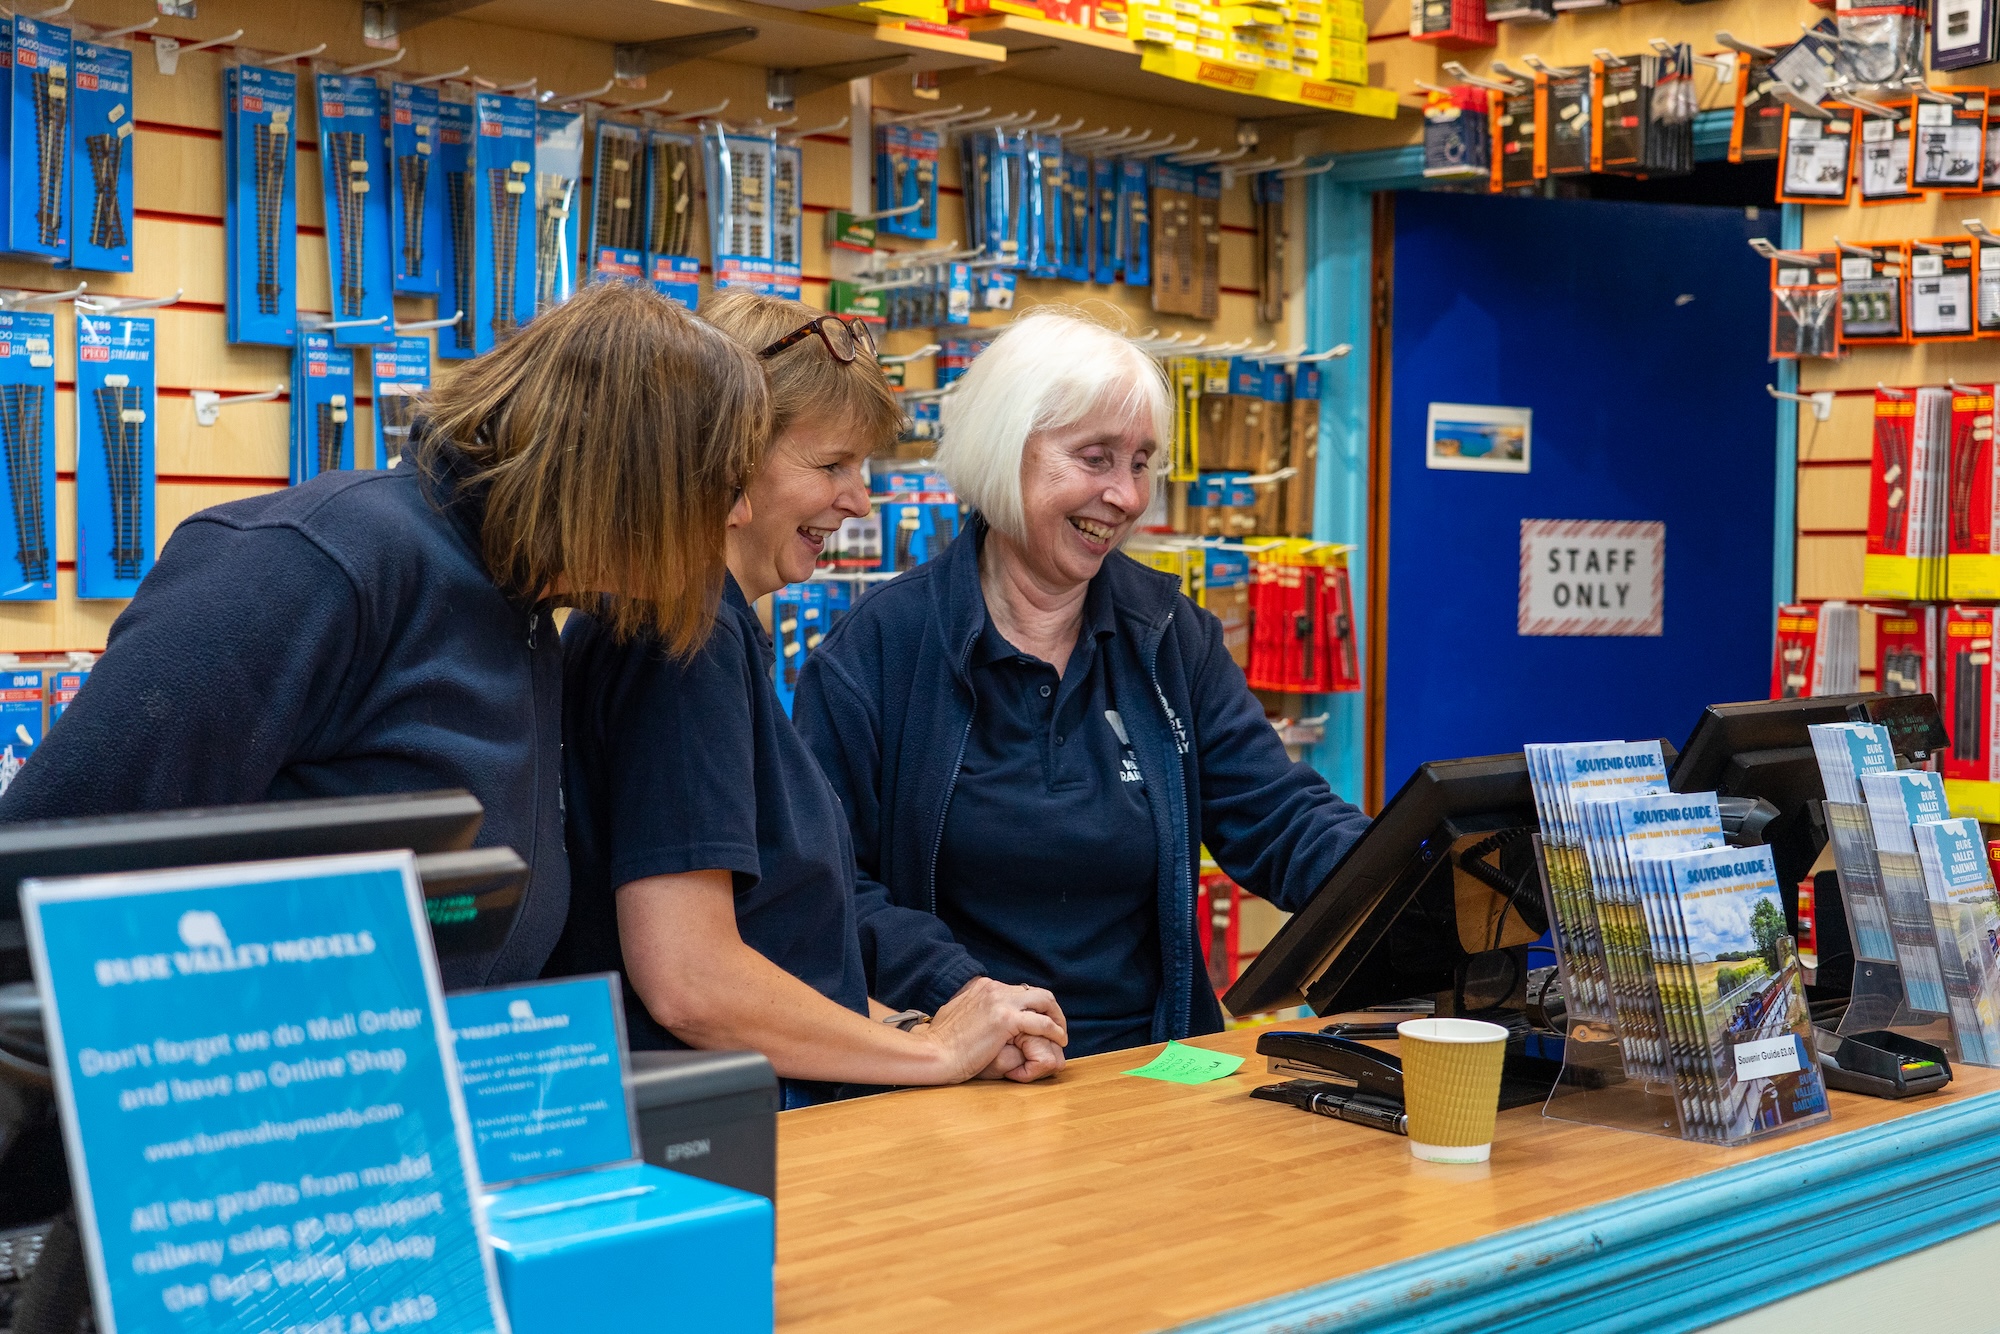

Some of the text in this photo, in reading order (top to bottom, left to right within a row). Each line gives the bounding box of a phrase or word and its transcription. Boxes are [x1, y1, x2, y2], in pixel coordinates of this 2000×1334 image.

[81, 320, 111, 331] SE96
[83, 347, 150, 362] PECO STREAMLINE
[1548, 547, 1637, 575] STAFF
[1553, 581, 1631, 610] ONLY
[1866, 743, 1884, 755] BURE
[1576, 754, 1656, 773] SOUVENIR GUIDE
[1863, 755, 1886, 767] VALLEY
[1861, 766, 1888, 776] RAILWAY
[1572, 781, 1589, 789] STEAM
[1590, 779, 1606, 788] TRAINS
[1623, 776, 1646, 785] NORFOLK
[1920, 790, 1938, 802] BURE
[1633, 805, 1712, 825] SOUVENIR GUIDE
[1917, 801, 1940, 813] VALLEY
[1916, 812, 1942, 824] RAILWAY
[1629, 832, 1646, 841] STEAM
[1647, 831, 1663, 839] TRAINS
[1670, 829, 1680, 837] THE
[1680, 827, 1701, 836] NORFOLK
[1955, 839, 1973, 851] BURE
[1952, 850, 1975, 863] VALLEY
[1687, 859, 1767, 884] SOUVENIR GUIDE
[1950, 861, 1978, 876] RAILWAY
[1684, 892, 1701, 901] STEAM
[1701, 889, 1717, 898] TRAINS
[1723, 886, 1733, 894] THE
[173, 942, 268, 976] VALLEY
[271, 930, 376, 963] MODELS
[459, 1021, 511, 1041] VALLEY
[79, 1006, 422, 1078] Don't forget we do Mail Order
[588, 1053, 610, 1067] and
[1738, 1046, 1796, 1065] Souvenir Guide £3.00
[119, 1047, 408, 1112] and have an Online Shop
[477, 1081, 535, 1097] volunteers
[1794, 1083, 1821, 1099] VALLEY
[1792, 1095, 1824, 1113] RAILWAY
[665, 1138, 711, 1163] EPSON
[130, 1153, 433, 1233] All the profits from model
[132, 1191, 443, 1275] railway sales go to support
[162, 1283, 209, 1313] the
[370, 1293, 438, 1333] CARD
